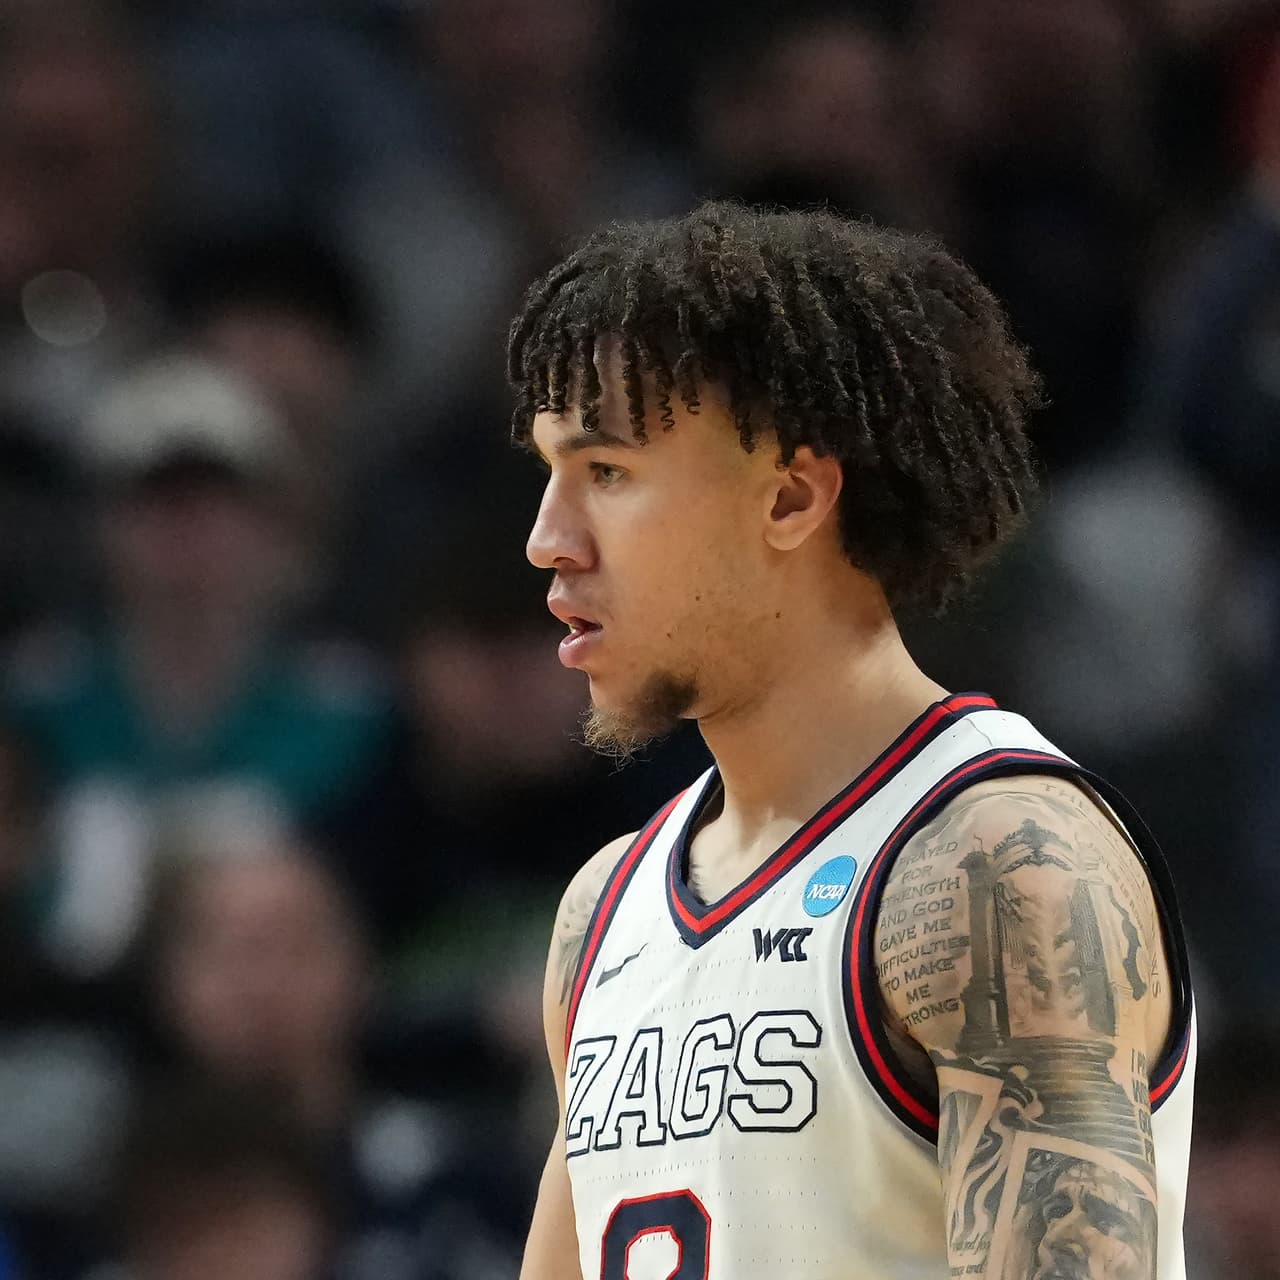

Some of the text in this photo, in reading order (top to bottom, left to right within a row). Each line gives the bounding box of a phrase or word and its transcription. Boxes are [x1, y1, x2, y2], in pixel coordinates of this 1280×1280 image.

[902, 865, 933, 884] FOR
[806, 884, 847, 899] NCAA
[880, 897, 954, 928] AND GOD
[752, 927, 814, 962] WCC
[880, 917, 952, 952] GAVE ME
[885, 958, 955, 994] TO MAKE
[906, 983, 931, 1004] ME
[566, 1010, 822, 1160] ZAGS
